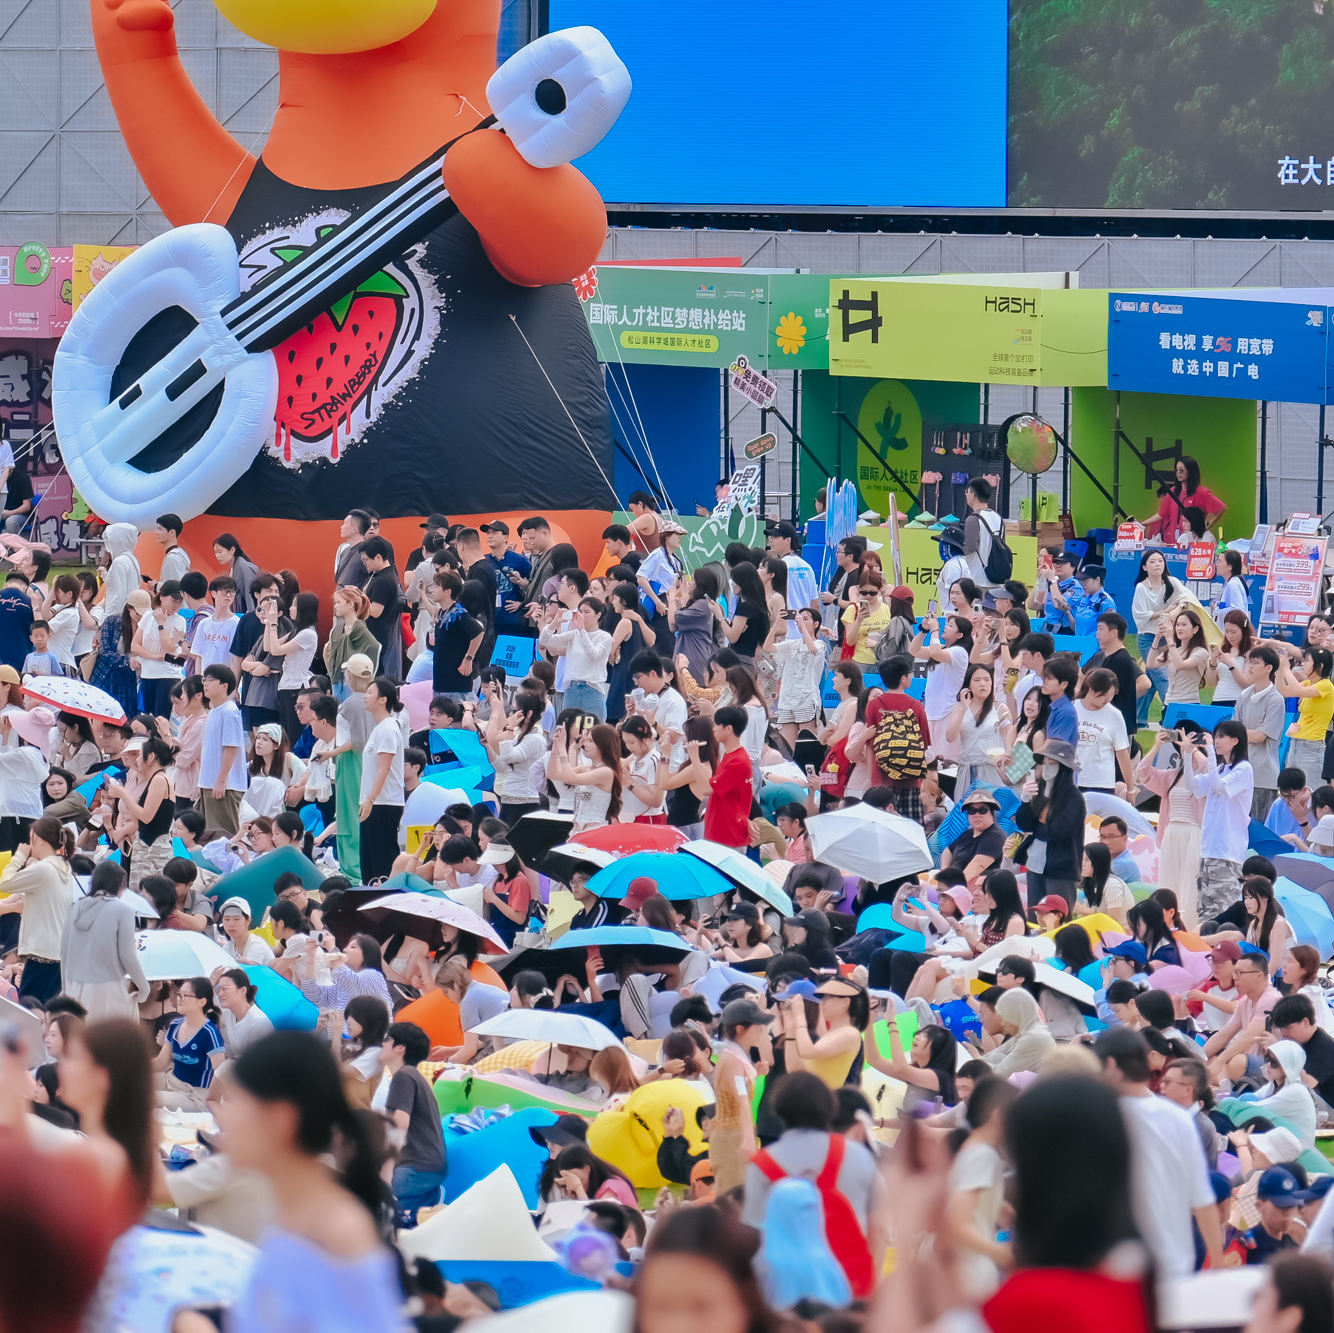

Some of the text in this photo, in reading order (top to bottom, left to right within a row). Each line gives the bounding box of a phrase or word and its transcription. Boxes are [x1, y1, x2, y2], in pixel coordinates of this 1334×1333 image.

[589, 302, 746, 332] 国际人才社区梦想补给站
[627, 335, 712, 349] 松山湖科学城国际人才社区
[1159, 332, 1274, 356] 看电视 享5G 用宽带
[992, 353, 1034, 364] 全球首个3D打印
[1172, 358, 1260, 379] 就选中国广电
[302, 348, 380, 430] STRAWBERRY
[743, 368, 774, 399] 免费领取
[860, 466, 919, 484] 国际人才社区
[204, 633, 229, 643] DREAM
